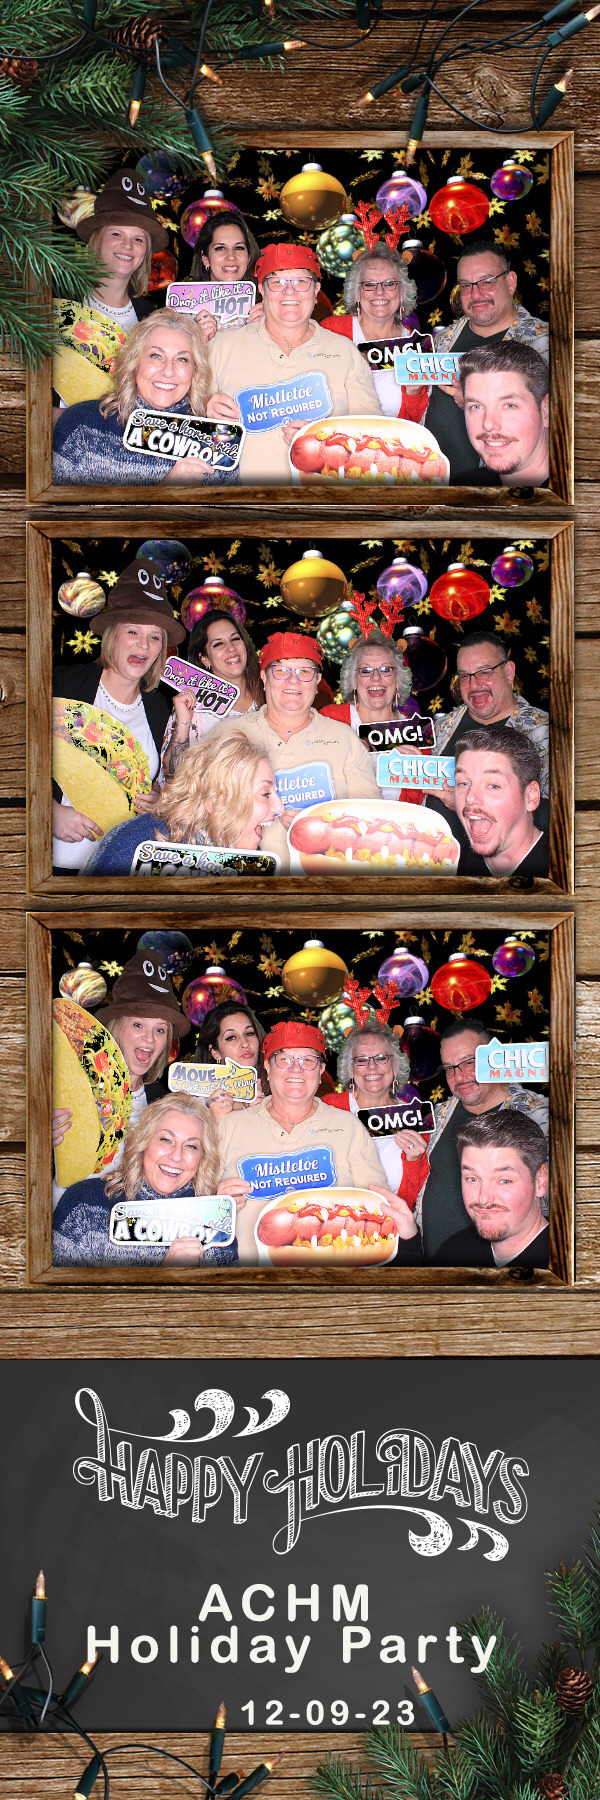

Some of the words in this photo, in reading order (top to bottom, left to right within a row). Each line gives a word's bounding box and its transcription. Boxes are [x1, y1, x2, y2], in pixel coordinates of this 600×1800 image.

[168, 293, 198, 309] Drop
[199, 288, 209, 304] it
[211, 285, 232, 300] like
[233, 283, 254, 295] it's
[214, 296, 250, 315] HOT
[408, 372, 459, 381] MAGNE
[250, 386, 313, 410] Mistletoe
[127, 427, 144, 447] A
[147, 429, 225, 465] COWBOY
[132, 411, 168, 428] Save
[168, 421, 179, 431] a
[216, 441, 238, 460] ride
[163, 664, 185, 687] Drop
[187, 674, 199, 687] it
[198, 676, 218, 690] like
[195, 688, 230, 713] HOT
[367, 725, 424, 746] OMG!
[388, 758, 452, 778] CHICK
[389, 775, 451, 786] MAGNET
[139, 843, 181, 862] Save
[183, 857, 195, 867] a
[488, 1047, 549, 1069] CHIC
[182, 1081, 199, 1091] Get
[200, 1081, 215, 1092] out
[367, 1110, 423, 1131] OMG!
[254, 1159, 319, 1178] Mistletoe
[114, 1204, 149, 1219] Save
[207, 1216, 232, 1234] ride
[114, 1220, 131, 1240] A
[133, 1218, 219, 1243] COWBOY
